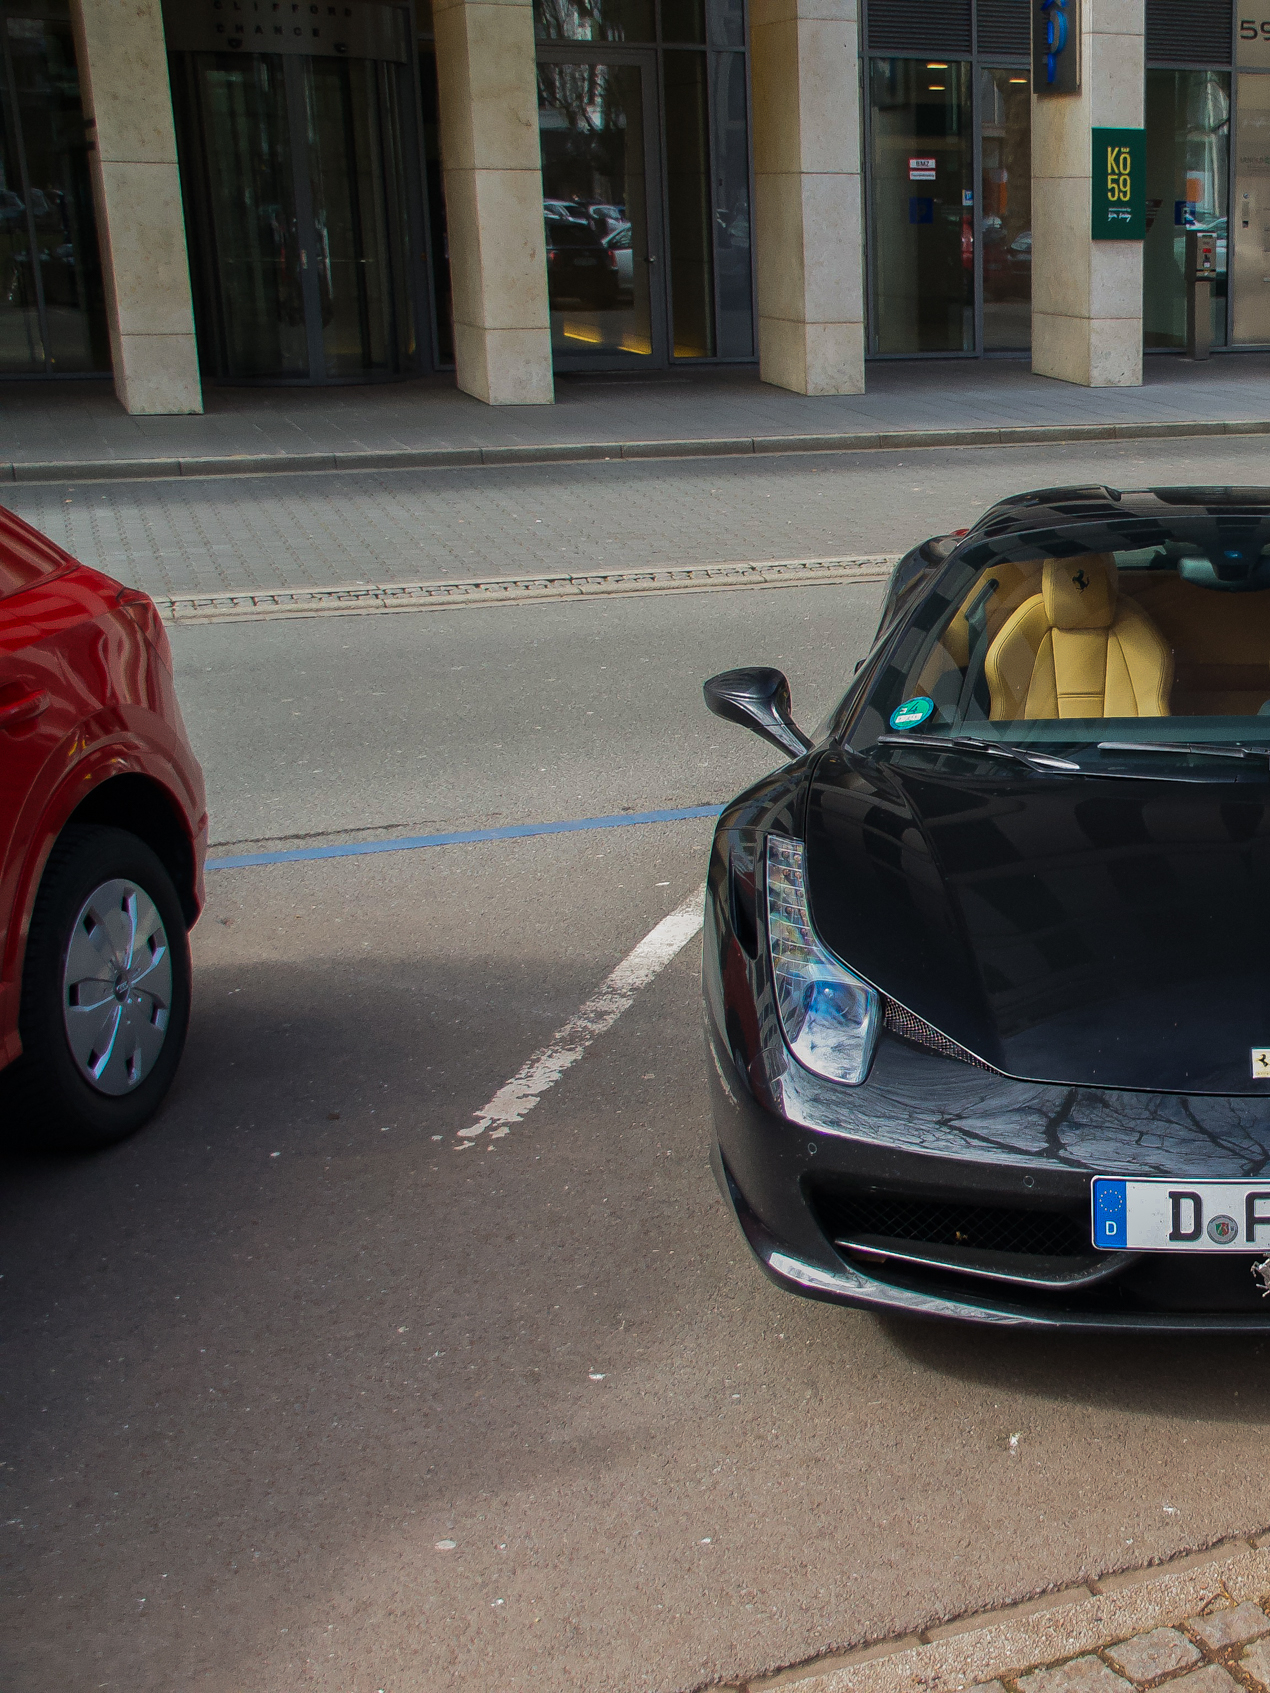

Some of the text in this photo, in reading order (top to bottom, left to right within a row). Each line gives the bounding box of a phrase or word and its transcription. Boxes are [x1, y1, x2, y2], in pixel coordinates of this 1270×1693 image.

[214, 0, 352, 17] CLIFFORD
[216, 23, 320, 38] CHANCE
[1107, 174, 1131, 201] 59
[1168, 1191, 1202, 1242] D
[1105, 1221, 1117, 1235] D
